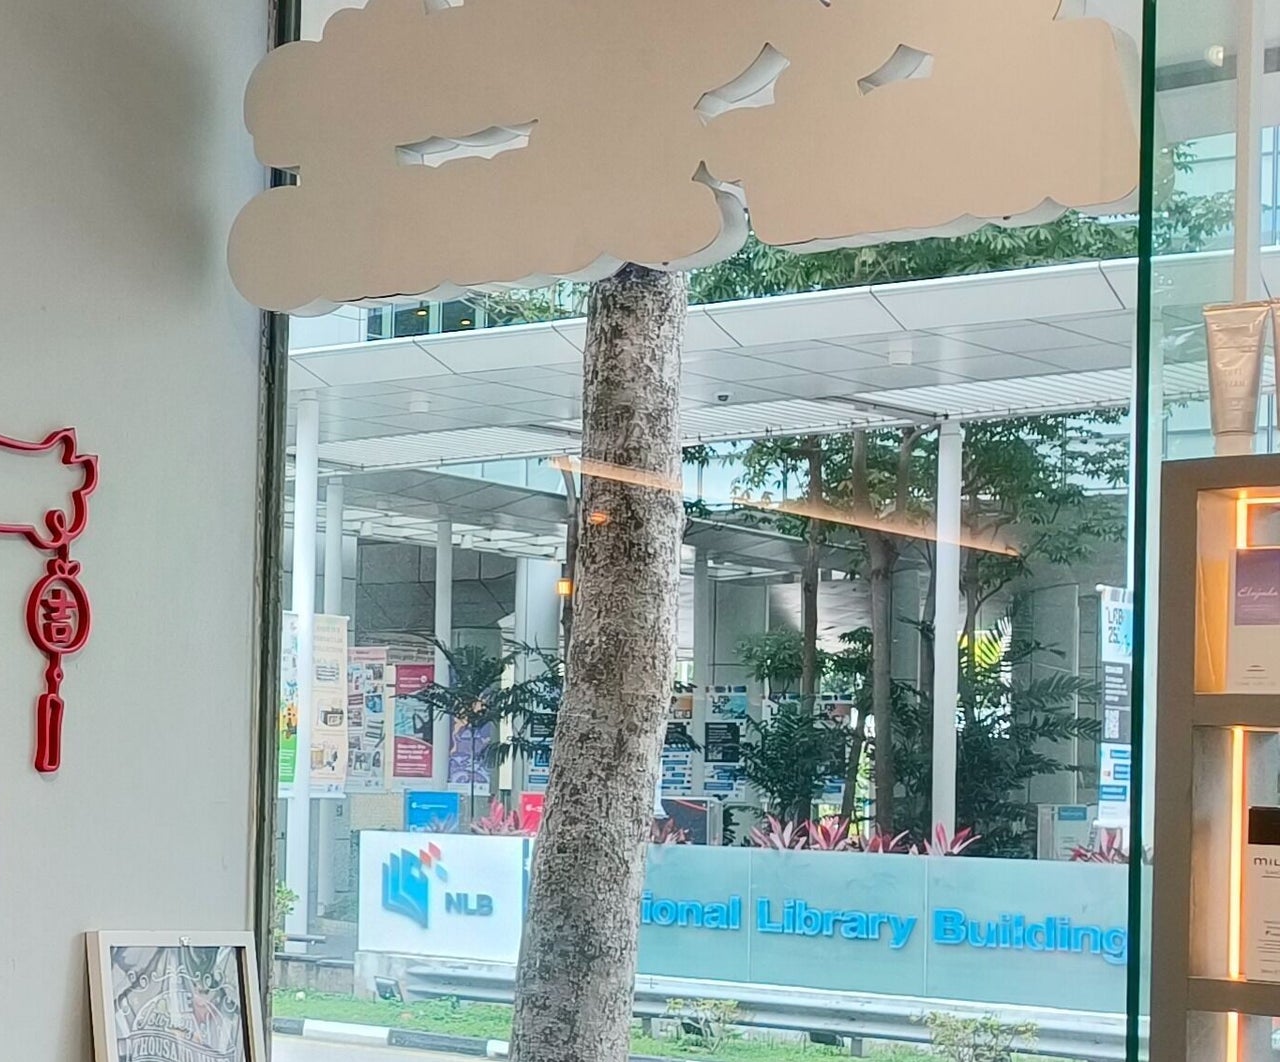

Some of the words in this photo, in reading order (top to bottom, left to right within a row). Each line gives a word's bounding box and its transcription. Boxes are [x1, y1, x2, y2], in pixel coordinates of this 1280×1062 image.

[445, 891, 494, 917] NLB
[640, 893, 740, 932] ional
[757, 896, 917, 950] Library
[932, 908, 1128, 965] Building
